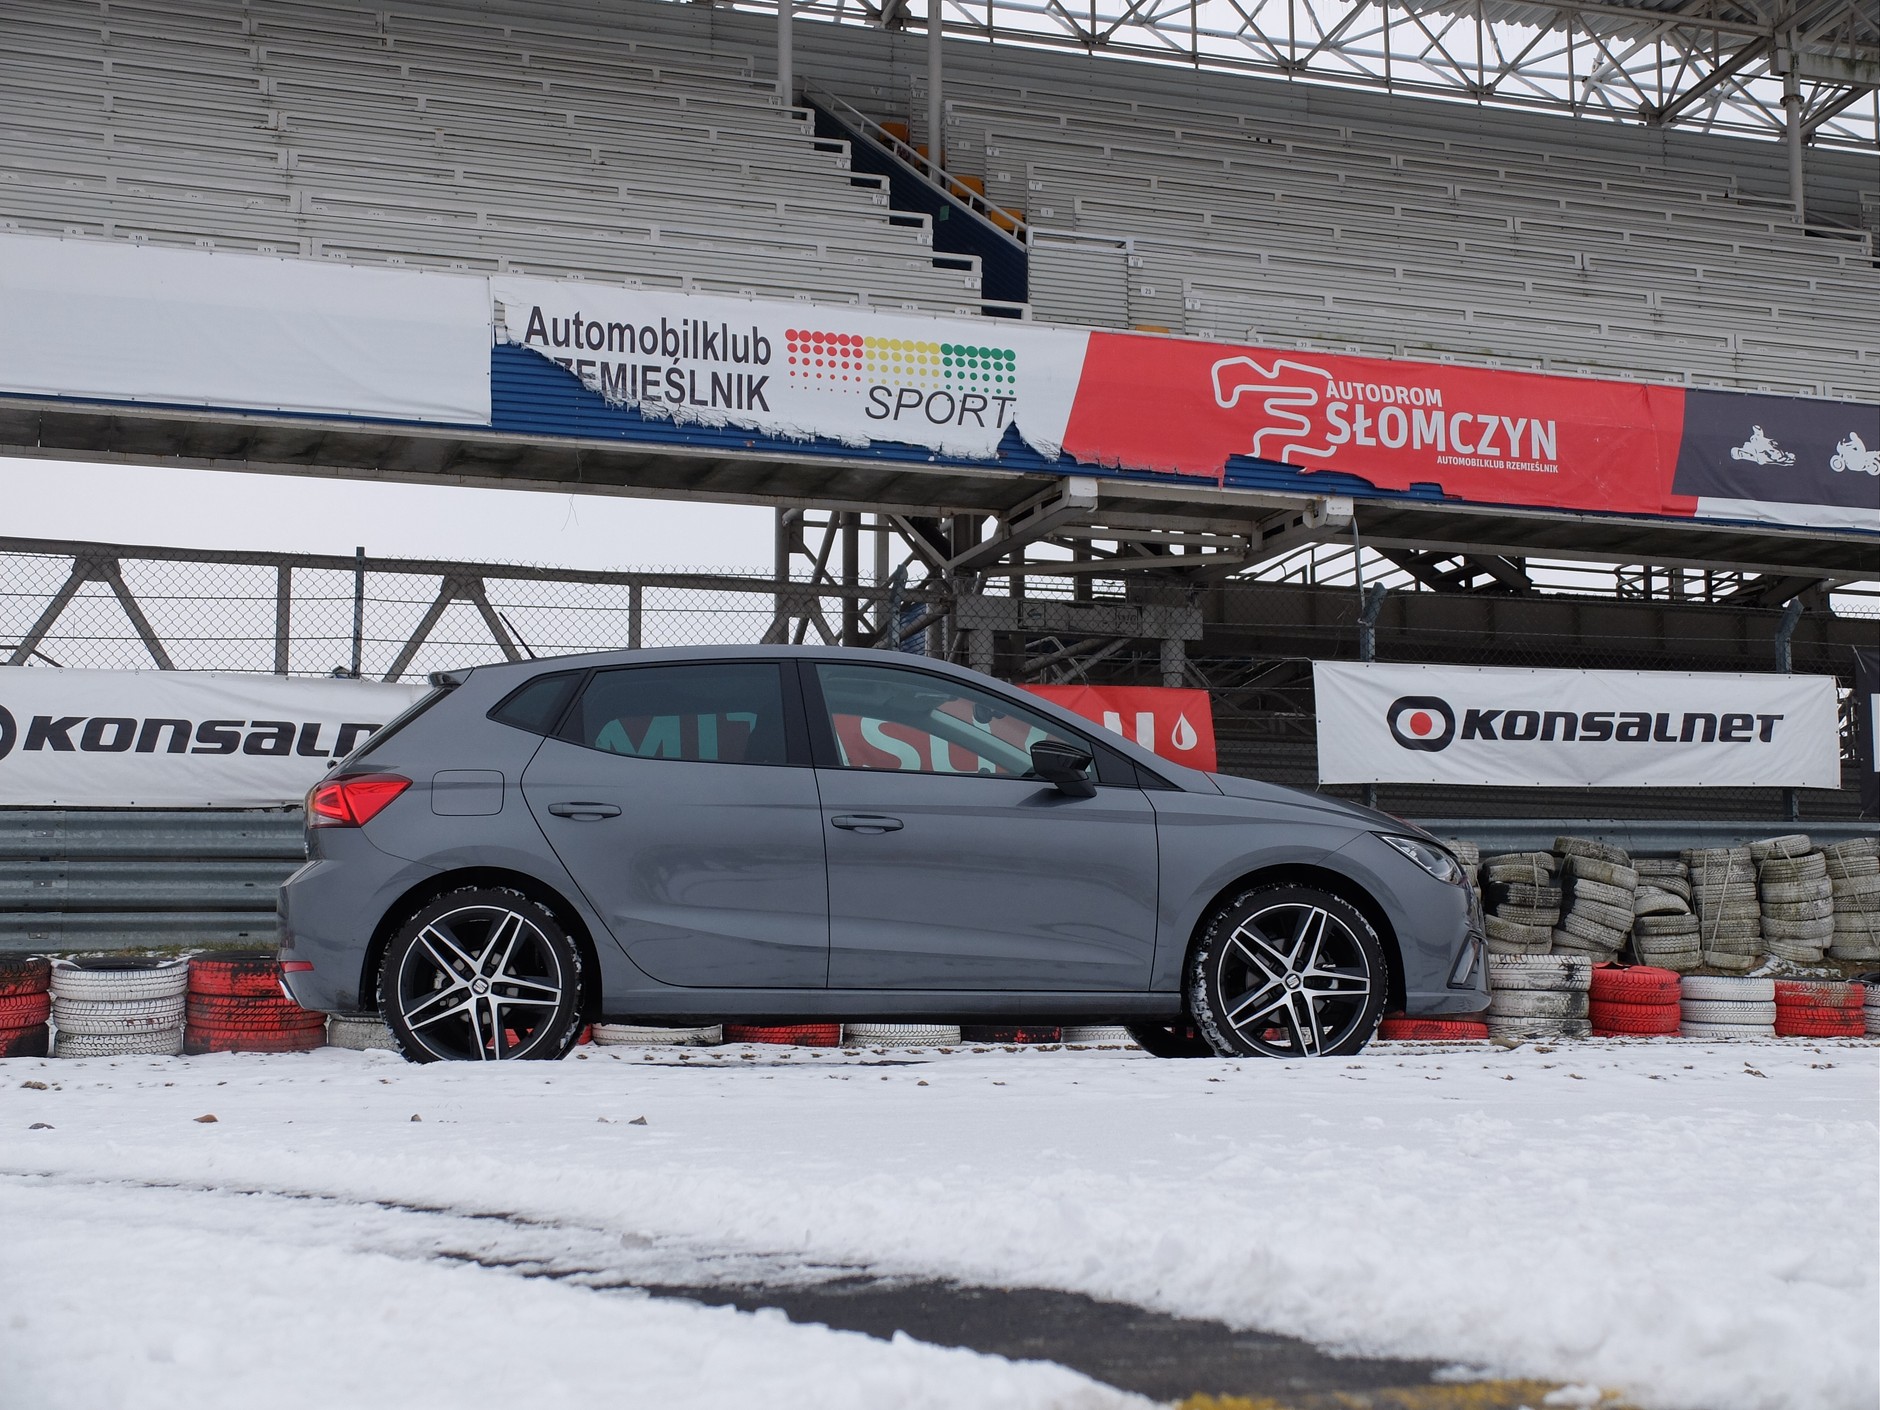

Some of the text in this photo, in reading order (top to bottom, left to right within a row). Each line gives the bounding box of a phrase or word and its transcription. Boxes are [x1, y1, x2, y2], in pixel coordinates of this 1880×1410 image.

[524, 305, 772, 366] Automobilklub
[864, 385, 1017, 429] SPORT
[1325, 379, 1443, 408] AUTODROM
[1325, 401, 1557, 461] SŁOMCZYN
[1436, 455, 1559, 474] AUTOMOBILKLUB RZEMIEŚLNIK
